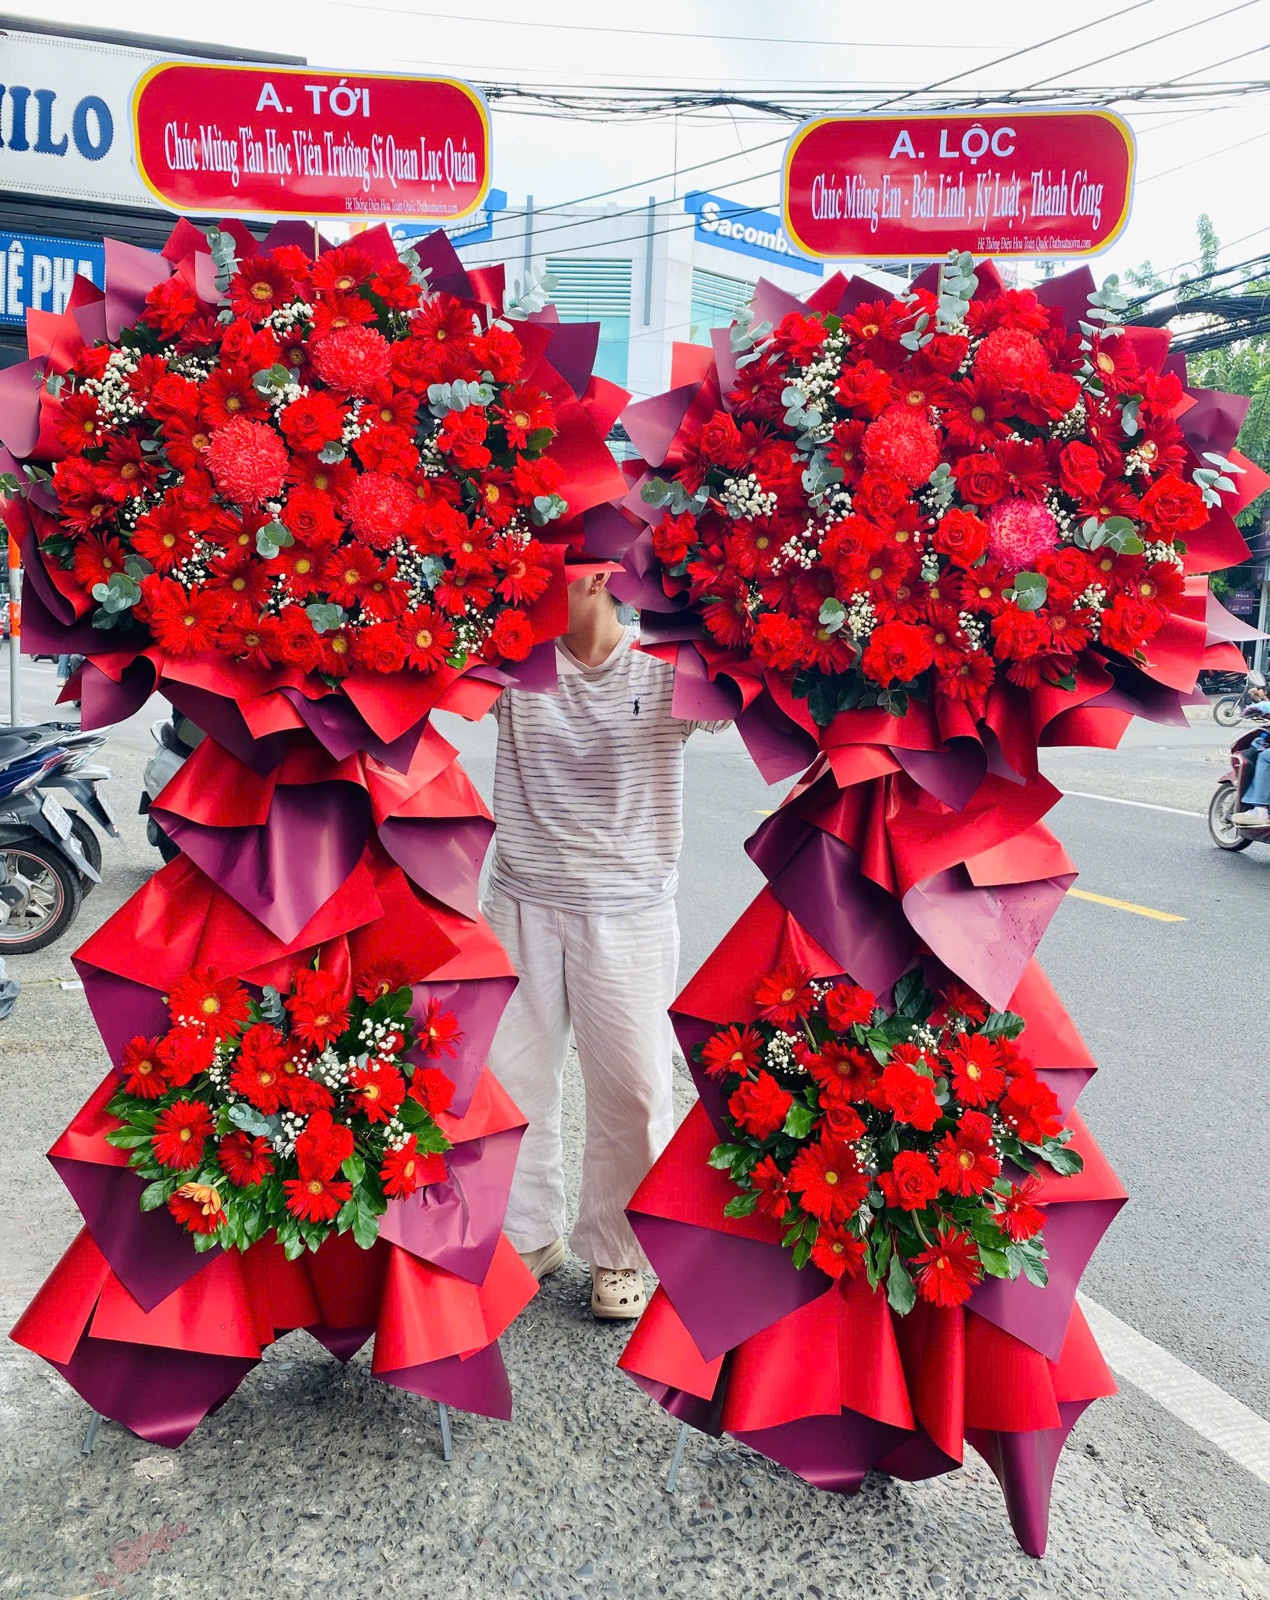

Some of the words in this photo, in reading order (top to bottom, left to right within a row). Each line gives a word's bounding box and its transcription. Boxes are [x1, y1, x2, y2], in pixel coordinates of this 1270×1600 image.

[0, 83, 114, 161] ILO
[255, 82, 293, 113] A.
[304, 79, 370, 117] TỚI
[164, 120, 199, 171] Chúc
[199, 124, 240, 188] Mừng
[239, 125, 265, 174] Tân
[265, 128, 292, 187] Học
[292, 129, 323, 176] Viên
[323, 130, 371, 193] Trường
[385, 134, 419, 189] Quan
[420, 136, 443, 193] Lục
[444, 136, 477, 191] Quân
[889, 129, 925, 159] A.
[939, 123, 1017, 165] LỘC
[380, 198, 391, 211] Hoa
[811, 173, 842, 220] Chúc
[844, 173, 880, 234] Mừng
[881, 174, 901, 219] Em
[911, 169, 935, 218] Bản
[974, 168, 992, 232] Kỷ
[1030, 168, 1068, 217] Thành
[1070, 168, 1104, 231] Công
[700, 201, 799, 256] Sacomb
[1012, 236, 1022, 250] Hoa
